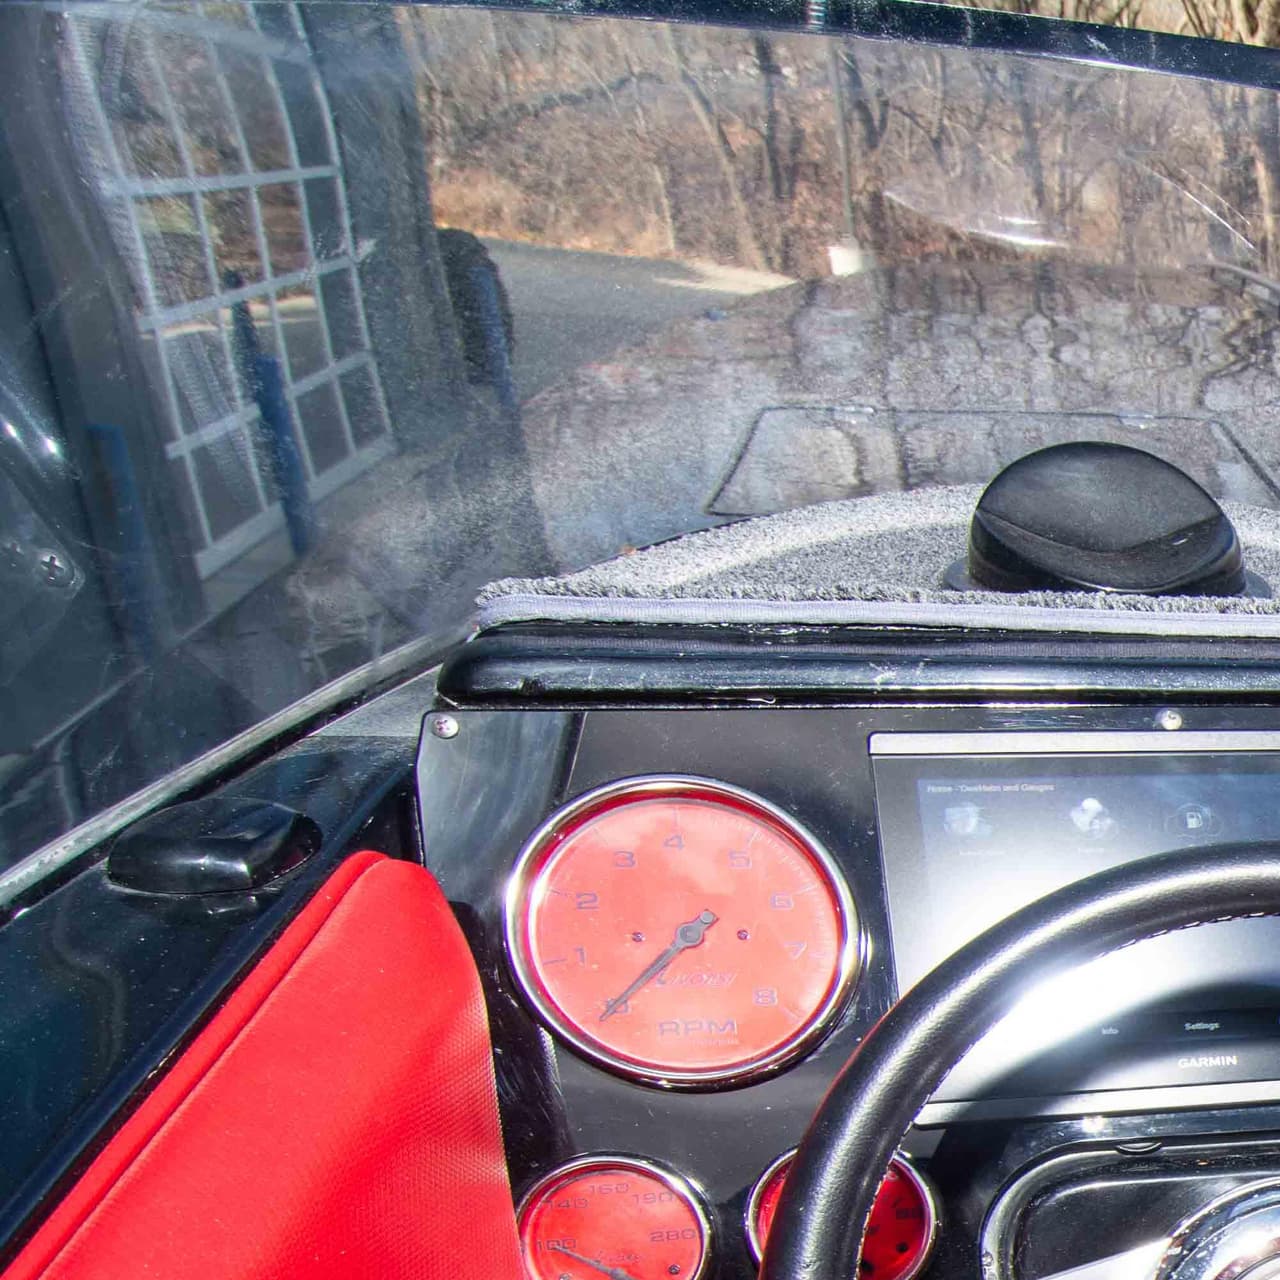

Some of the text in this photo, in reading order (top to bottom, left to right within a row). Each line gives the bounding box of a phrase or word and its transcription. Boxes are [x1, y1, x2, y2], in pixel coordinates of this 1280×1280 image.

[664, 835, 684, 851] 4
[614, 851, 635, 868] 3
[576, 893, 598, 909] 2
[1185, 1021, 1219, 1031] Settings
[1178, 1055, 1238, 1069] GARMIN
